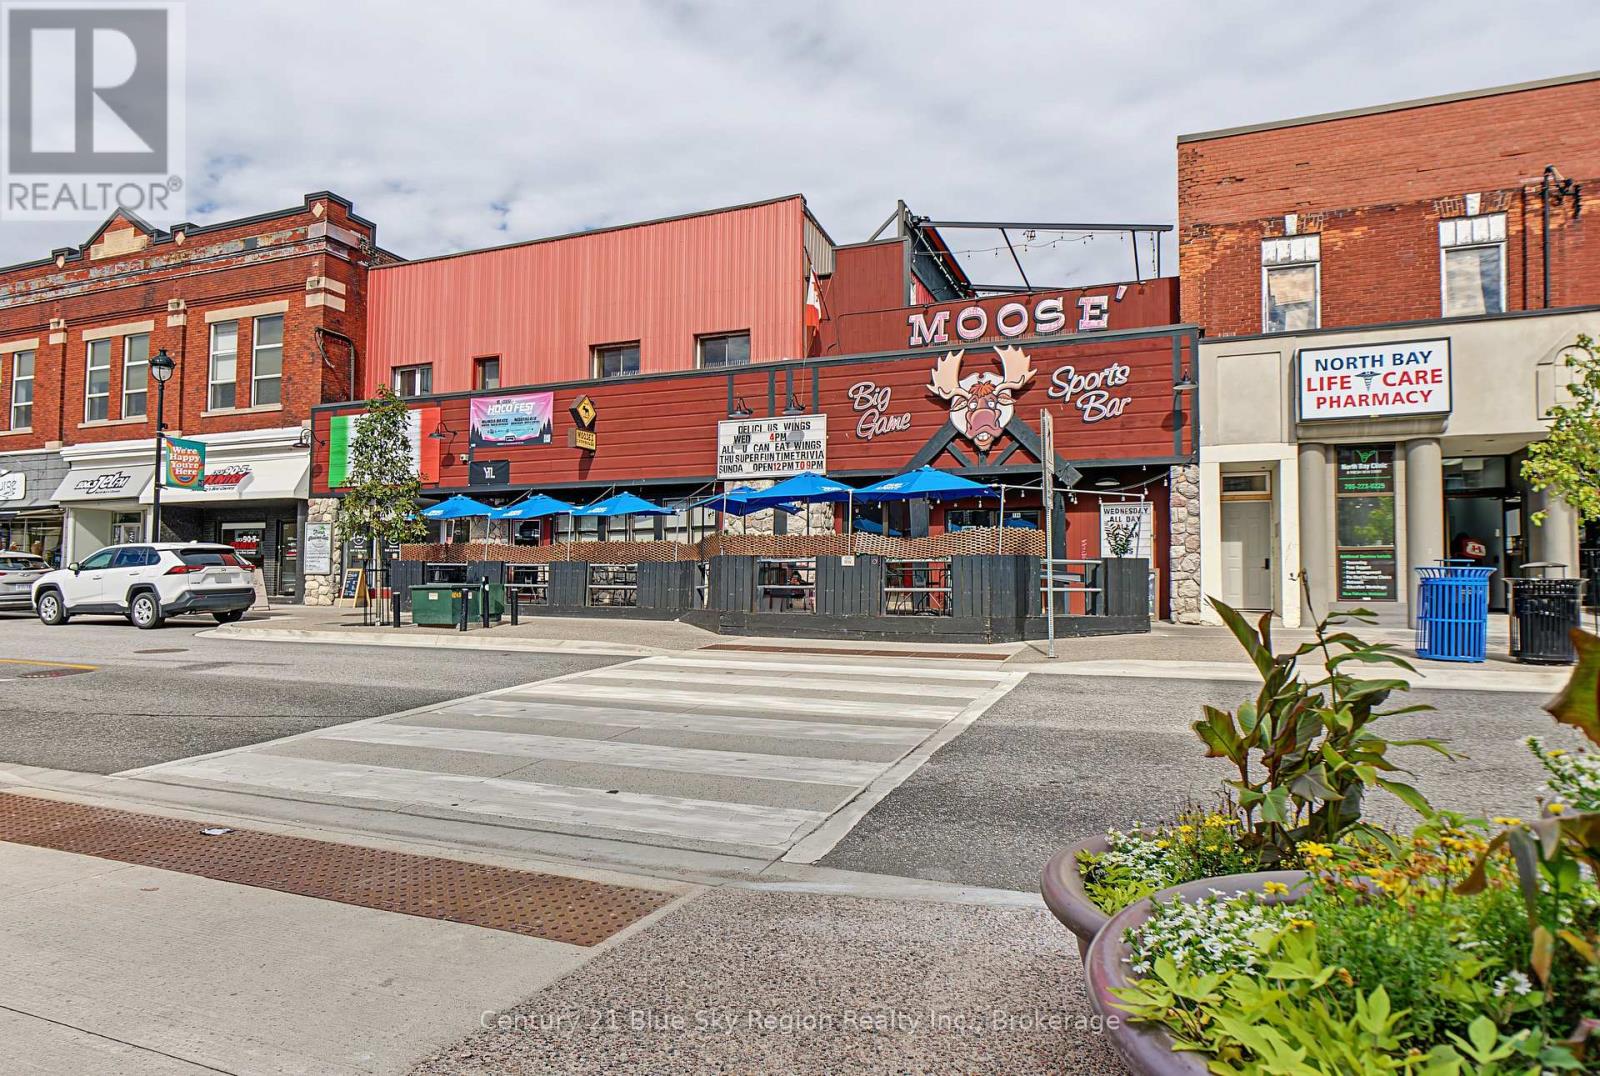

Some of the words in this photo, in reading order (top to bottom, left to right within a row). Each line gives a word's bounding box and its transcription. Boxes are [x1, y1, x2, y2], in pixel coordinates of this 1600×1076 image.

[1315, 354, 1384, 372] NORTH
[1392, 350, 1433, 366] BAY
[1047, 362, 1130, 403] Sports
[1306, 375, 1352, 392] LIFE
[1382, 368, 1443, 387] CARE
[848, 381, 891, 412] Big
[1316, 389, 1433, 409] PHARMACY
[1076, 389, 1132, 423] Bar
[784, 421, 811, 431] WINGS
[856, 408, 911, 440] Game
[734, 434, 751, 444] WED
[172, 447, 198, 455] We're
[722, 445, 736, 455] ALL
[742, 444, 748, 454] U
[754, 442, 770, 453] CAN
[775, 442, 790, 451] EAT
[794, 440, 822, 451] WINGS
[169, 453, 201, 463] Happy
[735, 452, 759, 463] SUPER
[760, 452, 775, 462] FUN
[776, 451, 795, 462] TIME
[796, 450, 825, 460] TRIVIA
[170, 460, 200, 469] You're
[175, 467, 198, 475] Here
[1358, 463, 1370, 471] Bay
